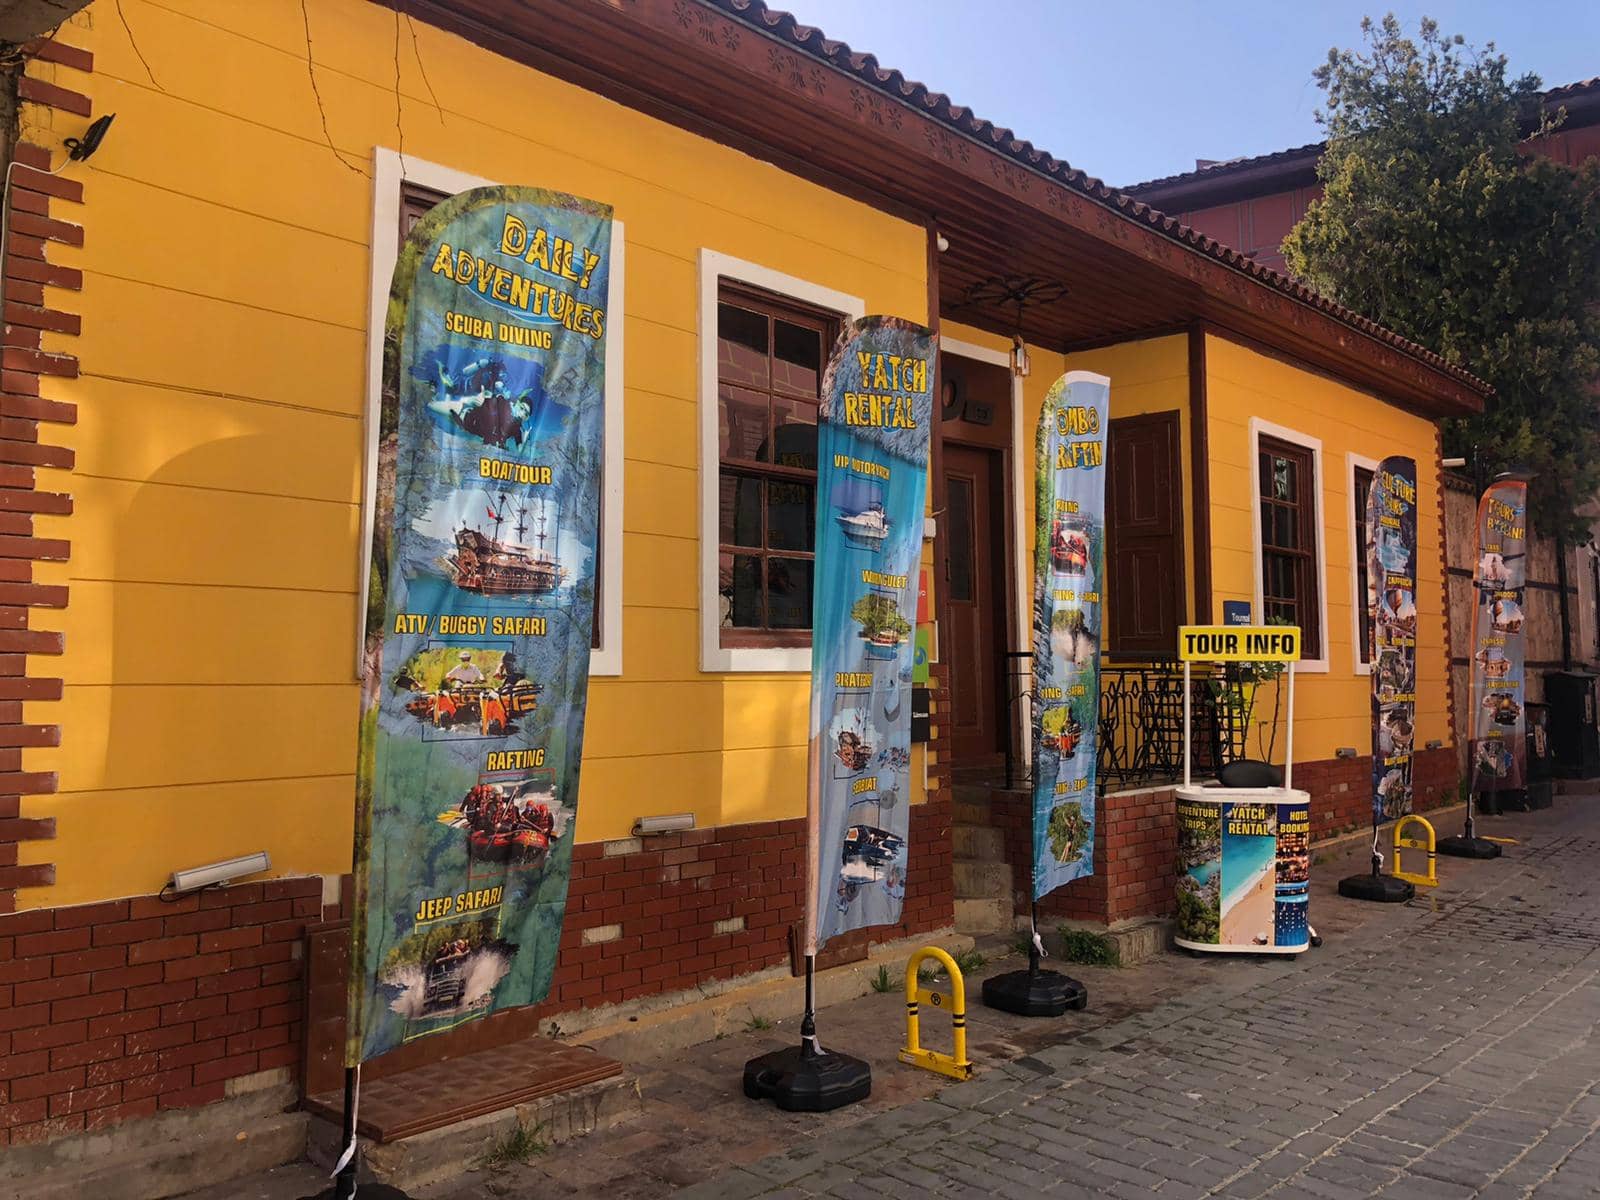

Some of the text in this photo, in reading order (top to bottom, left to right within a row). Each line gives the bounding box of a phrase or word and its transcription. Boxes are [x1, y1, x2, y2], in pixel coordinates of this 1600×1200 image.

[502, 213, 600, 289] DAILY
[431, 243, 605, 339] ADVENTURES
[445, 312, 552, 349] SCUBA DIVING
[857, 351, 926, 394] YATCH
[844, 391, 917, 430] RENTAL
[479, 457, 552, 484] BOAT TOUR
[834, 454, 849, 468] VIP
[1382, 471, 1416, 505] CULTURE
[394, 614, 428, 635] ATV
[439, 616, 487, 635] BUGGY
[492, 617, 546, 635] SAFARI
[1185, 634, 1295, 654] TOUR INFO
[487, 749, 545, 771] RAFTING
[1184, 819, 1207, 830] TRIPS
[1232, 807, 1265, 820] YATCH
[1228, 822, 1269, 835] RENTAL
[416, 886, 503, 921] JEEP SAFARI
